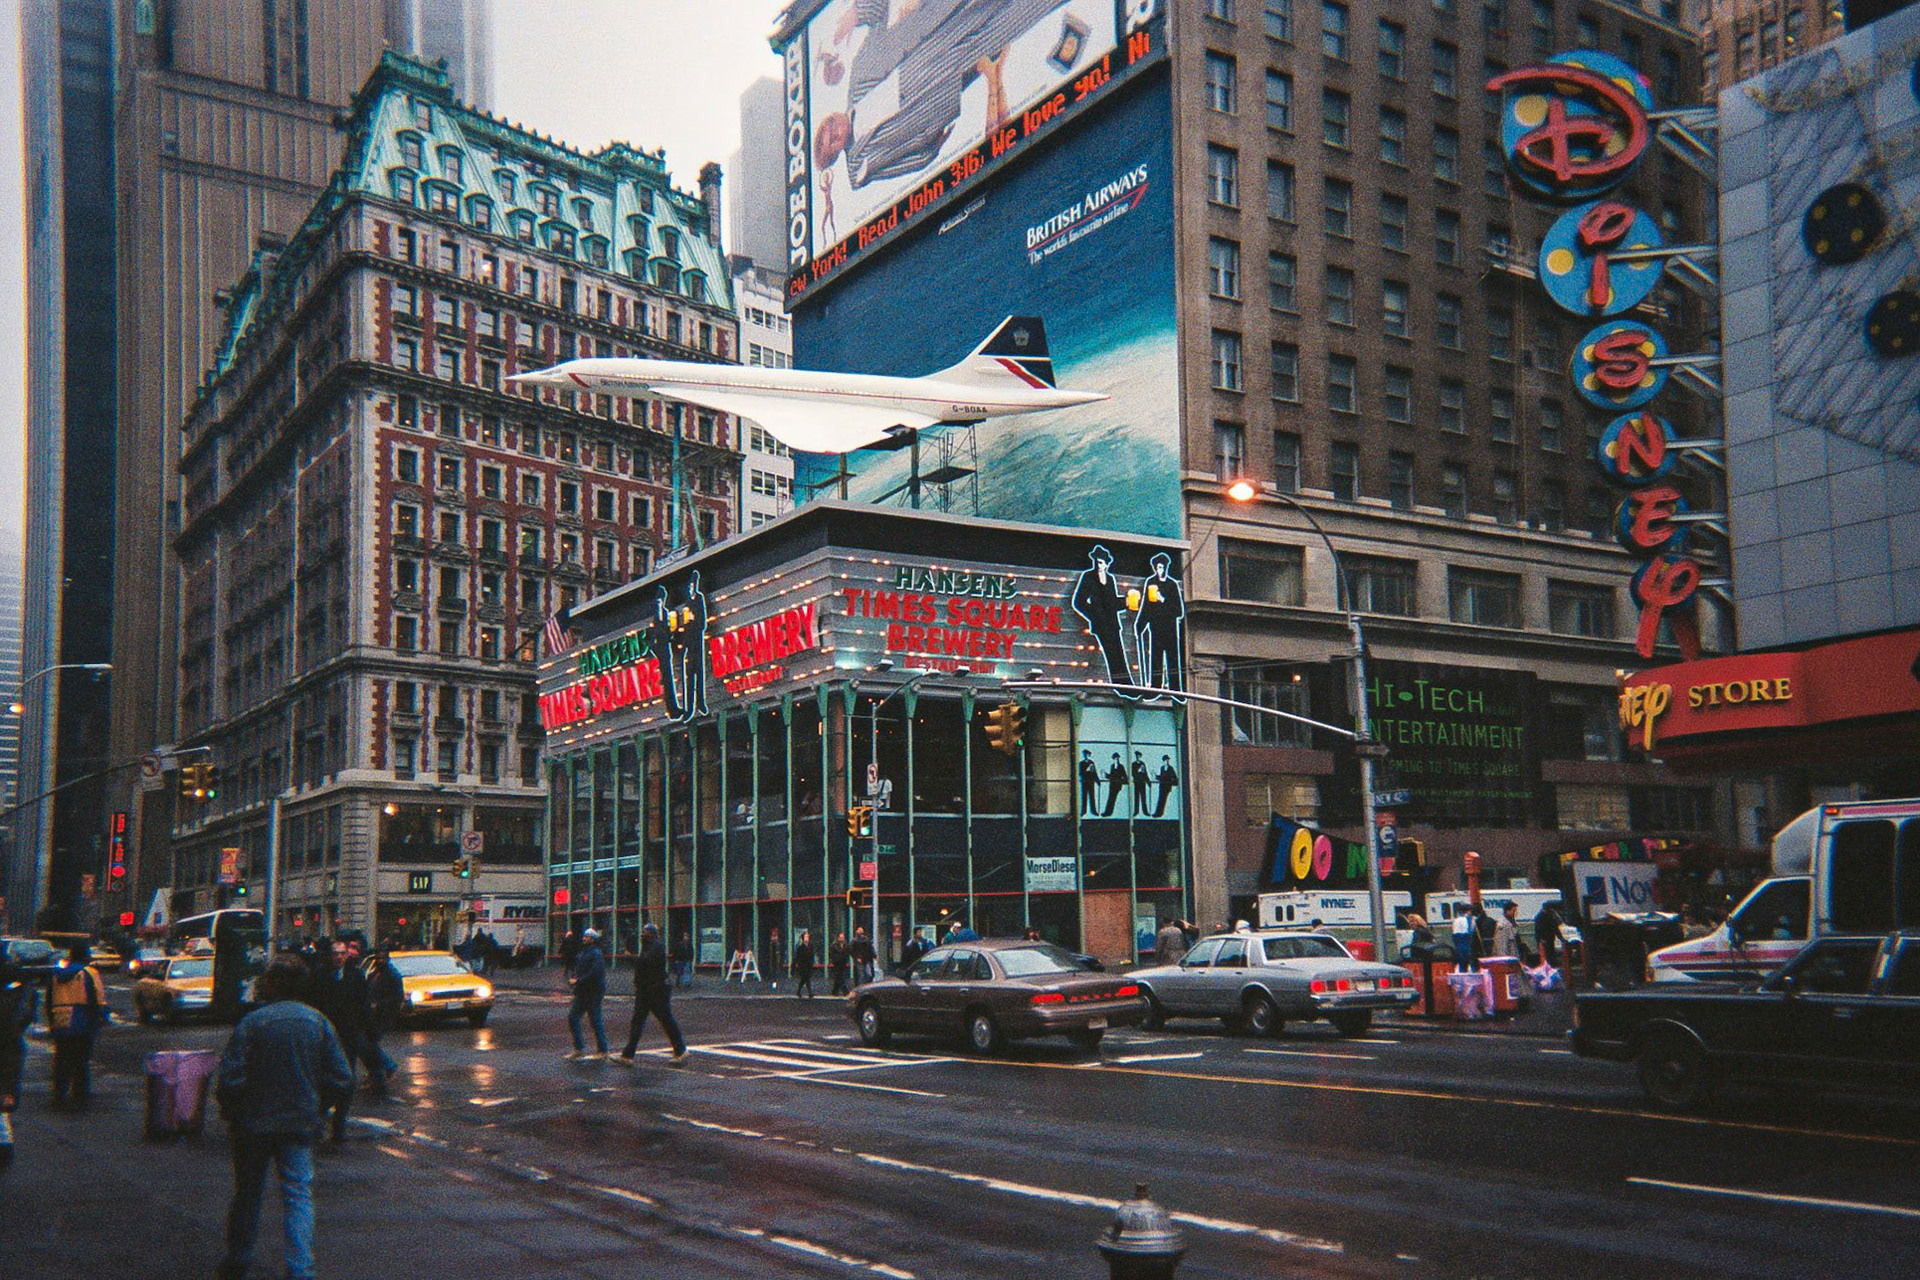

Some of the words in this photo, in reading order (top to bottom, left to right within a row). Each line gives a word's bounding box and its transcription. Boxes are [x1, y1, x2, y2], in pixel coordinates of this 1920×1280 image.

[811, 239, 848, 281] York!
[857, 205, 898, 250] Read
[903, 178, 944, 218] John
[991, 128, 1017, 158] We
[1022, 93, 1066, 136] love
[1074, 55, 1111, 102] ya!
[789, 184, 808, 267] JOE
[1026, 202, 1082, 249] BRITISH
[1084, 164, 1148, 215] AIRWAYS
[842, 588, 938, 624] TIMES
[946, 598, 1062, 633] SQUARE
[896, 566, 1018, 600] HANSENS
[540, 683, 587, 731] TIMES
[589, 657, 665, 716] SQUARE
[709, 604, 816, 679] BREWERY
[887, 624, 1017, 658] BREWERY
[1688, 678, 1793, 707] STORE
